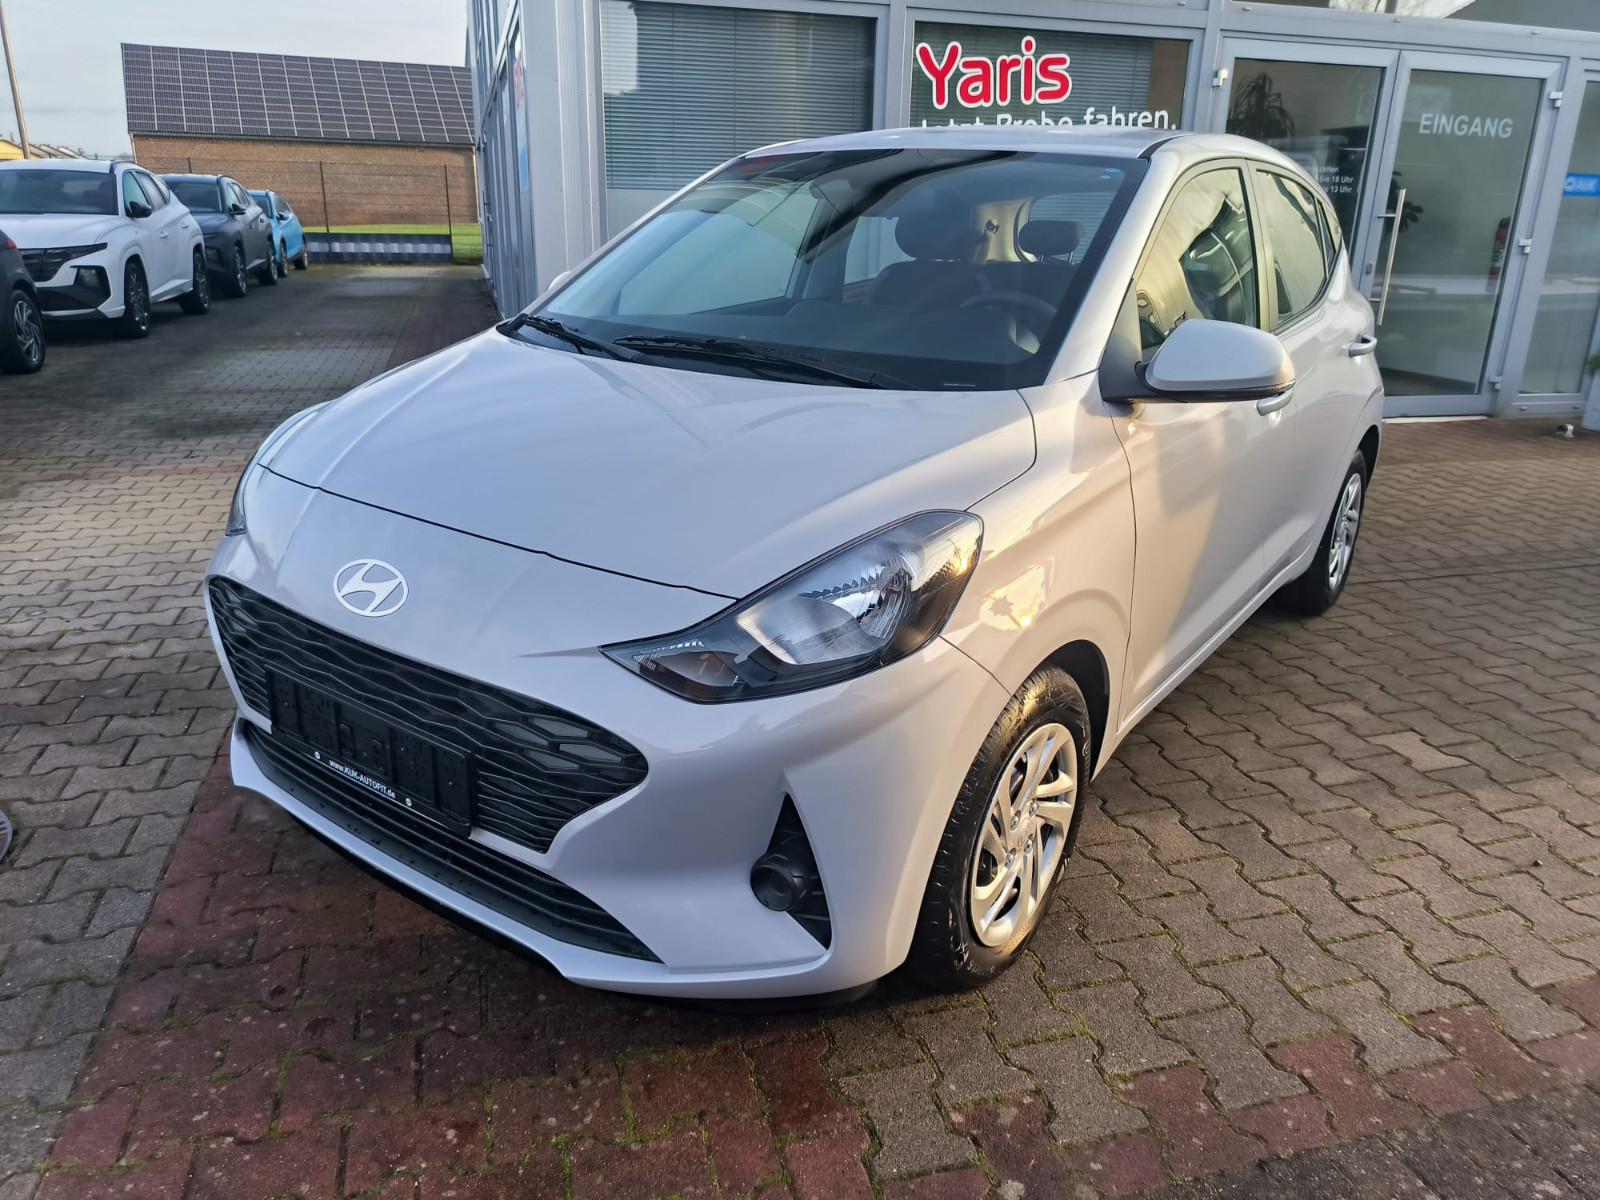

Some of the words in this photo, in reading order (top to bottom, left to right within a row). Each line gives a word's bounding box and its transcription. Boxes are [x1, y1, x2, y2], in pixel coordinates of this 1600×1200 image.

[915, 35, 1072, 109] Yaris
[1419, 113, 1513, 138] EINGANG
[1341, 175, 1354, 184] Uhr
[1340, 185, 1353, 193] Uhr
